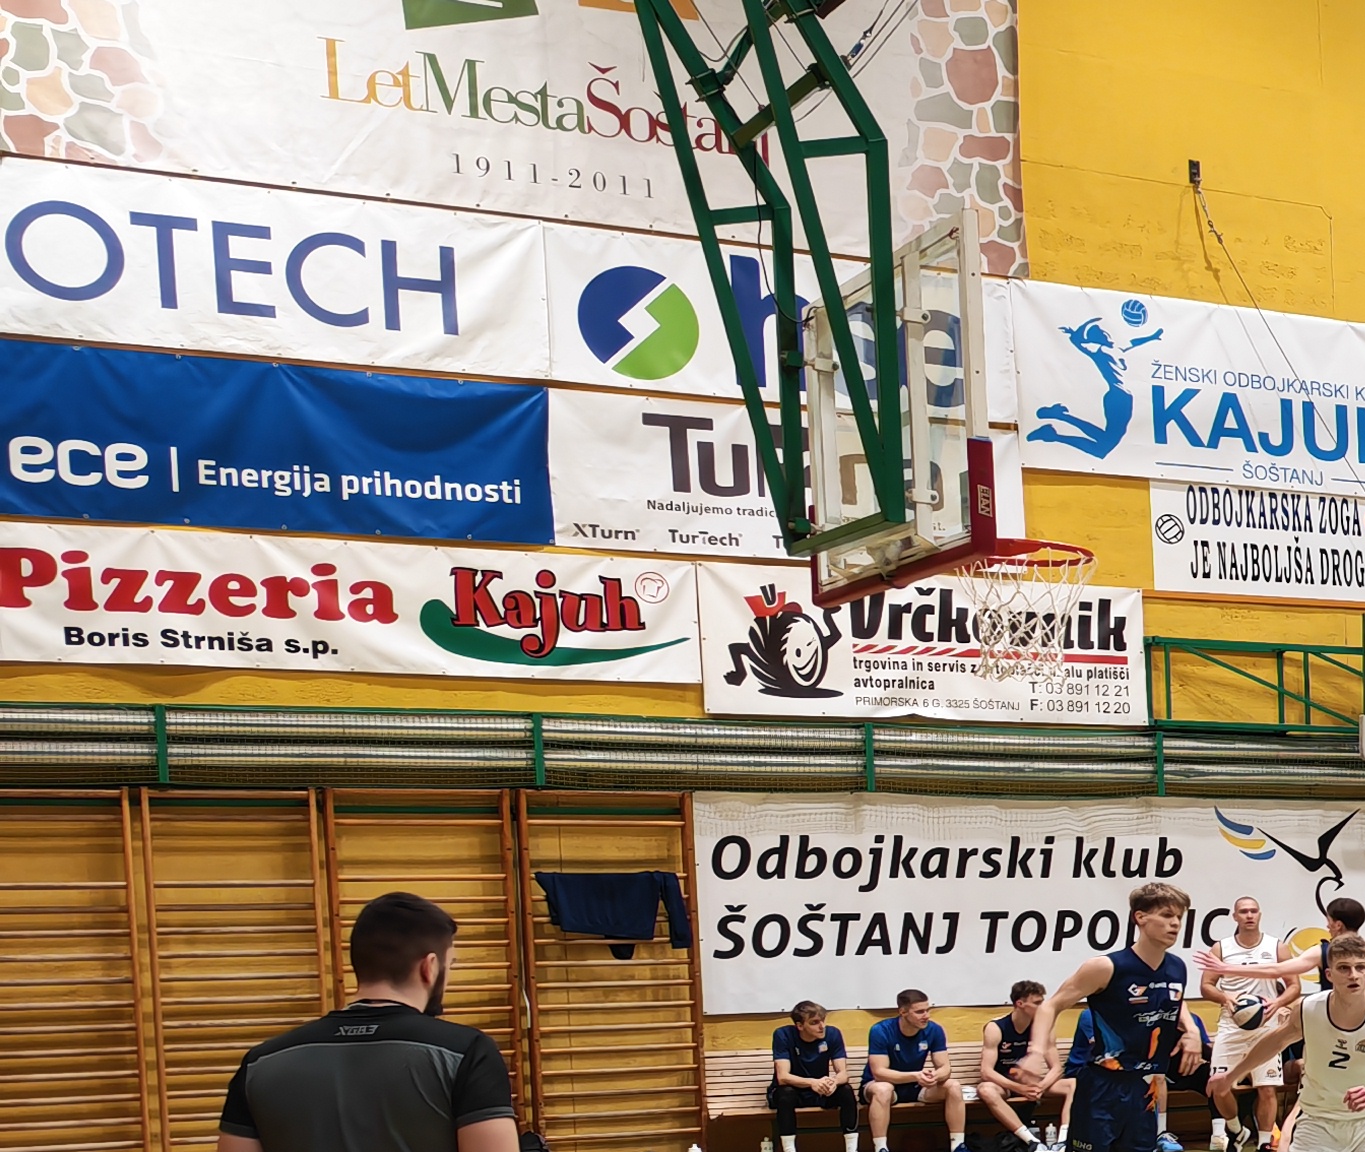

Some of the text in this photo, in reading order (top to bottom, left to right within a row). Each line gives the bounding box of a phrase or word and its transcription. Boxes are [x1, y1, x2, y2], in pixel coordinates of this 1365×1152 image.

[451, 152, 654, 199] 1911-2011
[4, 199, 460, 336] OTECH
[1150, 359, 1217, 386] ŽENSKI
[1222, 370, 1349, 397] ODBOJKARSKI
[8, 435, 150, 490] ece
[197, 457, 522, 505] Energija prihodnosti
[1242, 459, 1324, 487] ŠOŠTANJ
[647, 500, 733, 516] Nadaljujemo
[1187, 485, 1362, 536] ODBOJKARSKA ZOGA
[668, 529, 740, 547] TurTech
[1191, 540, 1211, 579] JE
[1217, 535, 1315, 586] NAJBOLJŠA
[0, 547, 398, 625] Pizzeria
[449, 566, 645, 658] Kajuh
[64, 626, 339, 659] Boris Strniša s.p.
[853, 656, 908, 673] trgovina
[912, 657, 924, 671] in
[928, 660, 966, 674] servis
[1086, 666, 1130, 681] platišči
[853, 676, 935, 692] avtopralnica
[1029, 682, 1130, 697] T: 03 891 12 21
[855, 696, 919, 708] PRIMORSKA
[922, 699, 930, 708] 6
[945, 699, 970, 709] 3325
[973, 698, 1020, 711] ŠOŠTANJ
[1030, 699, 1131, 714] F: 03 891 12 20
[711, 835, 1183, 892] Odbojkarski klub
[712, 902, 959, 958] ŠOŠTANJ
